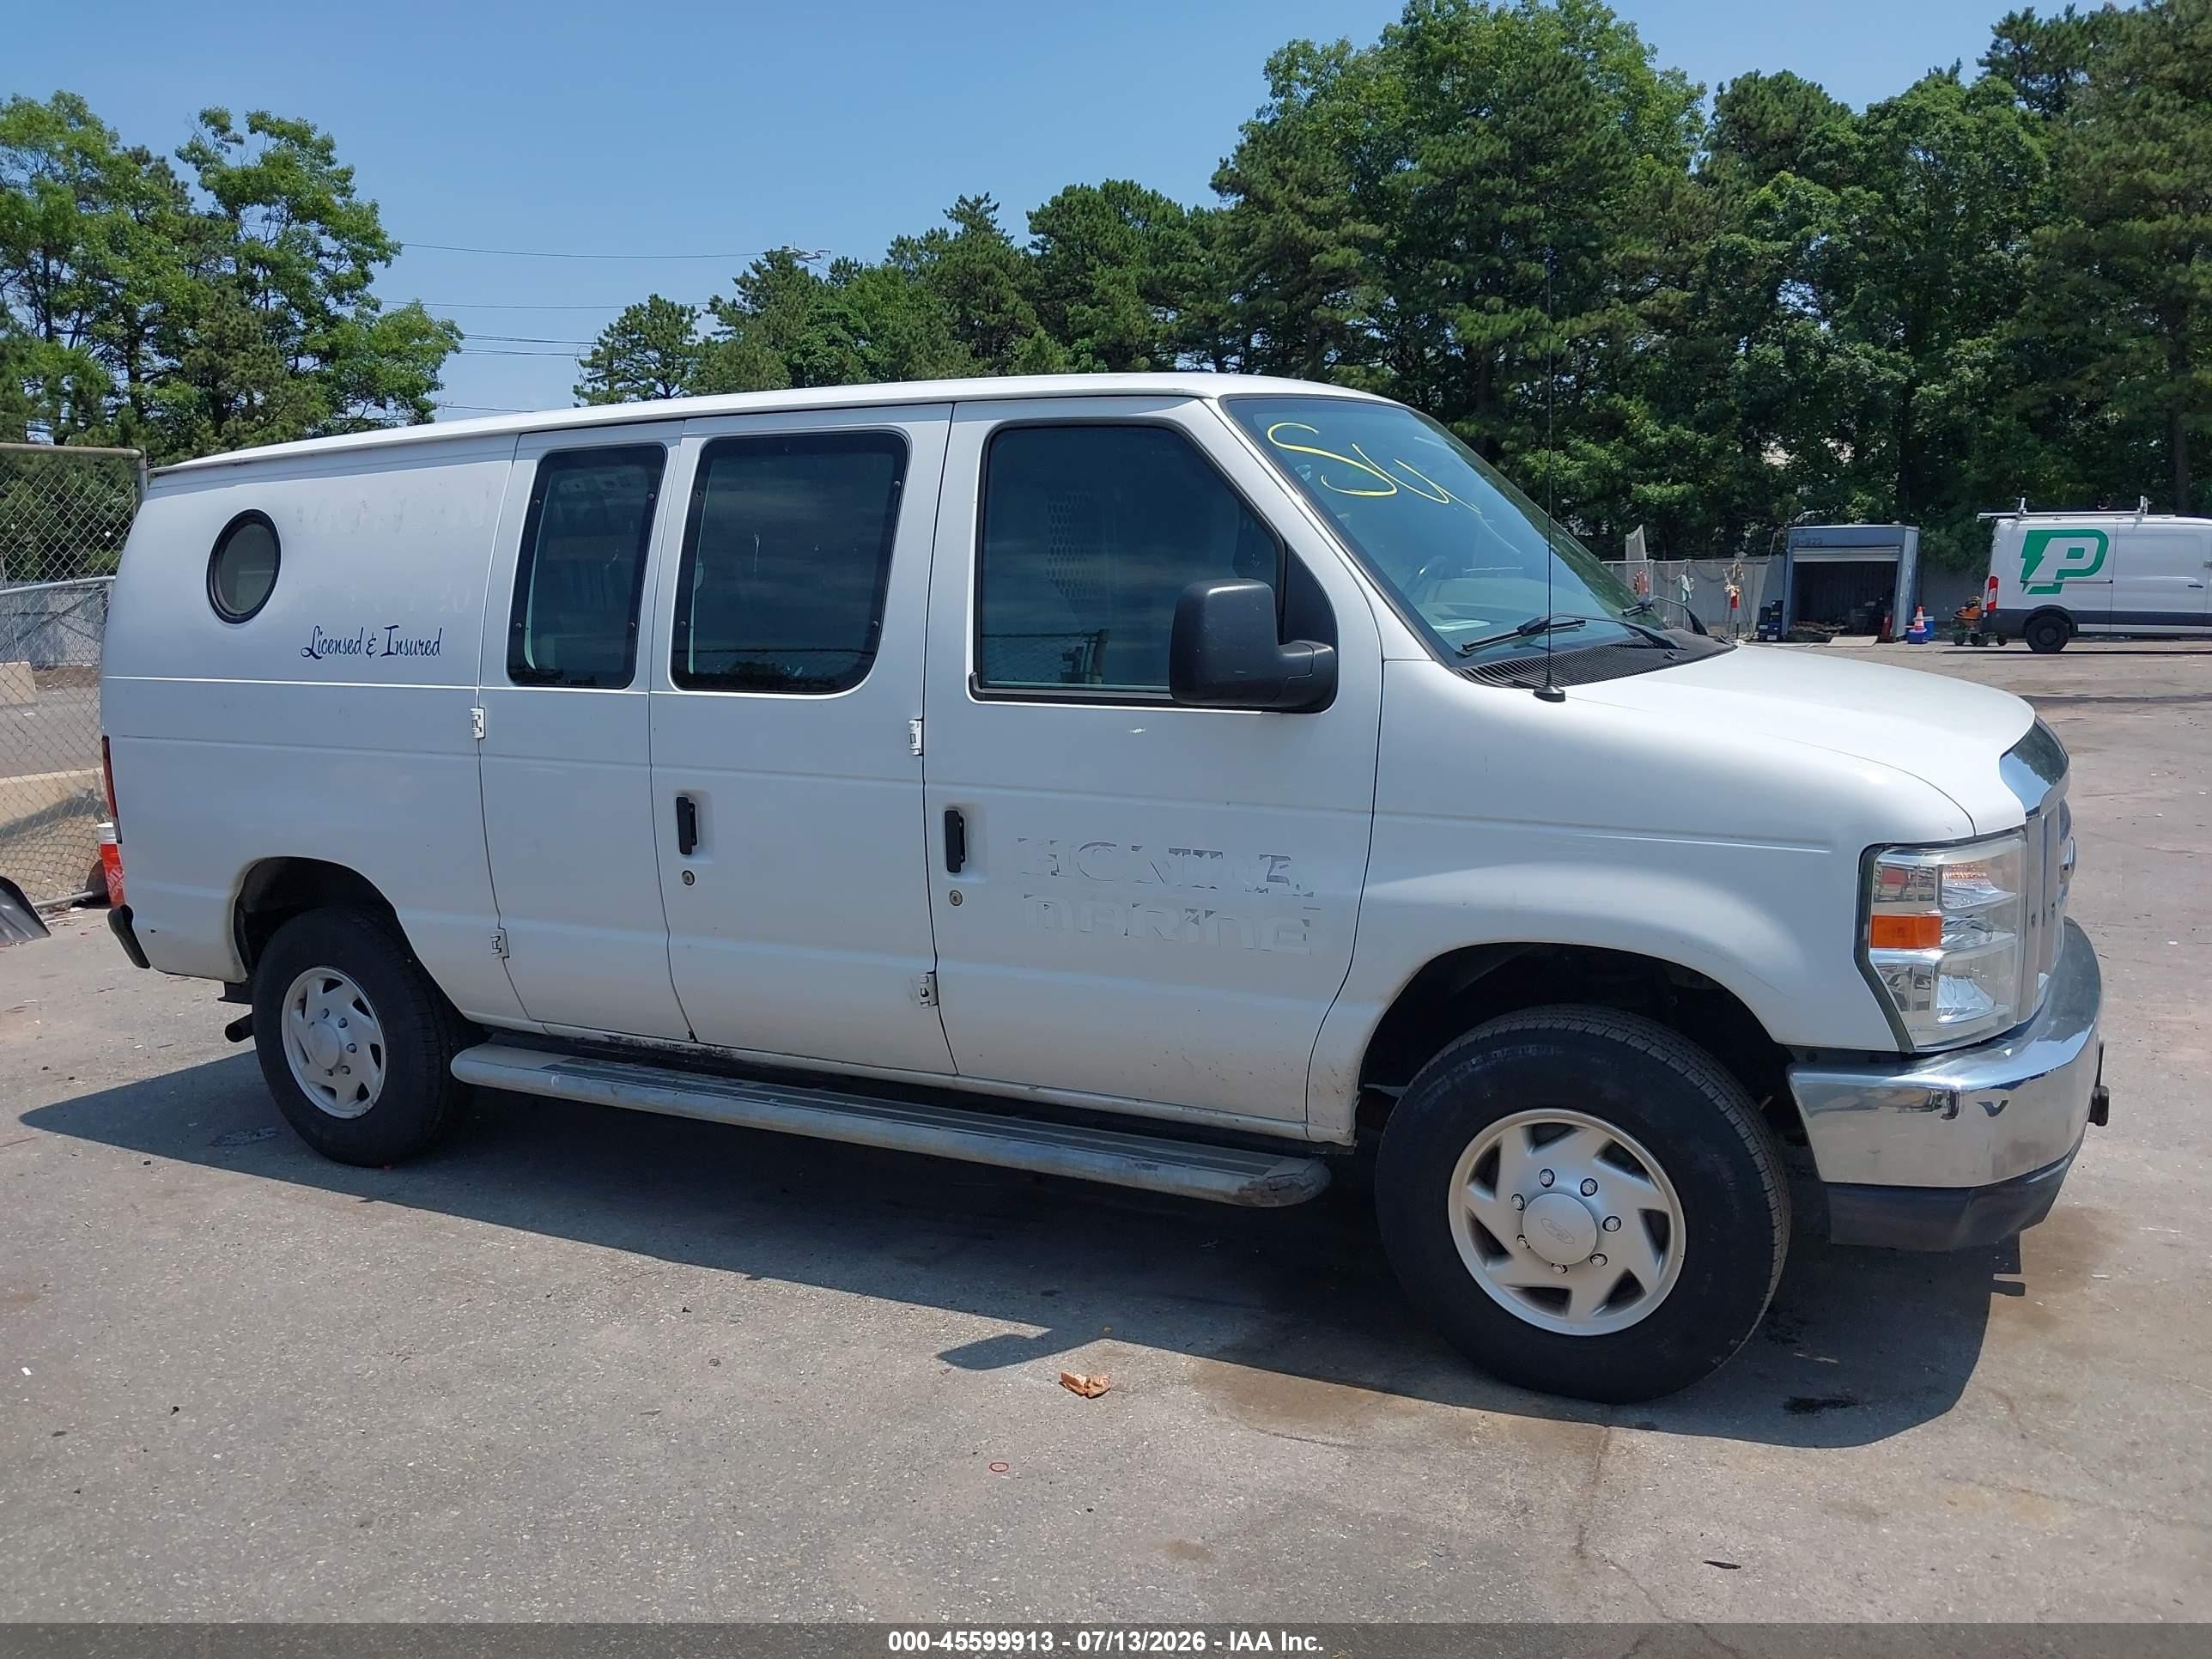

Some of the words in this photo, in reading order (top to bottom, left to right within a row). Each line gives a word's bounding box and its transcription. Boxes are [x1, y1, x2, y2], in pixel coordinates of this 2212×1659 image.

[301, 625, 364, 660] Licensed
[366, 632, 377, 659] &
[380, 624, 442, 657] Insured
